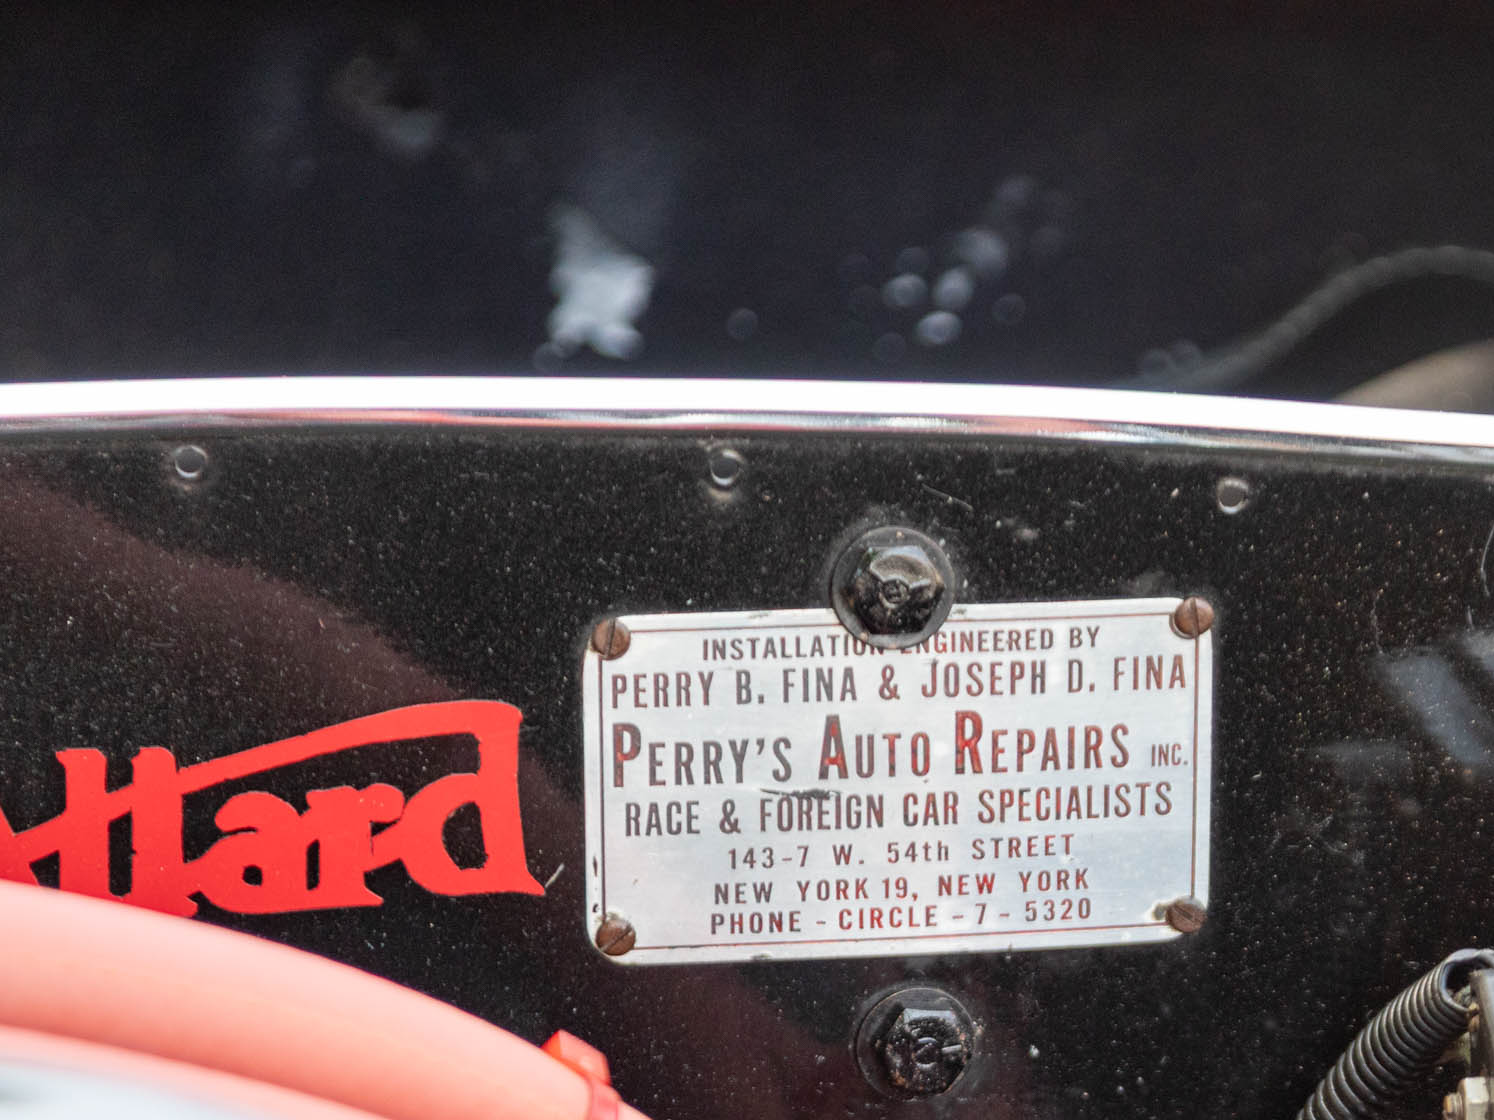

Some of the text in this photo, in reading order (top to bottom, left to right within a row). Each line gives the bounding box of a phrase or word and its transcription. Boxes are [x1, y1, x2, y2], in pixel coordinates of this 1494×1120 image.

[900, 628, 1054, 655] NGINEERED
[1070, 627, 1099, 648] BY
[612, 655, 1185, 708] PERRY B. FINA & JOSEPH D. FINA
[819, 715, 930, 782] AUTO
[955, 711, 1129, 774] REPAIRS
[1151, 741, 1190, 770] INC.
[0, 699, 546, 917] llard
[626, 782, 1171, 836] RACE & FOREIGN CAR SPECIALISTS
[833, 844, 864, 865] W.
[888, 841, 948, 863] 54th
[972, 834, 1073, 860] STREET
[715, 868, 1088, 904] NEW YORK 19, NEW YORK
[711, 911, 800, 935] PHONE
[838, 903, 937, 931] CIRCLE
[976, 904, 986, 924] 7
[1026, 898, 1090, 921] 5320
